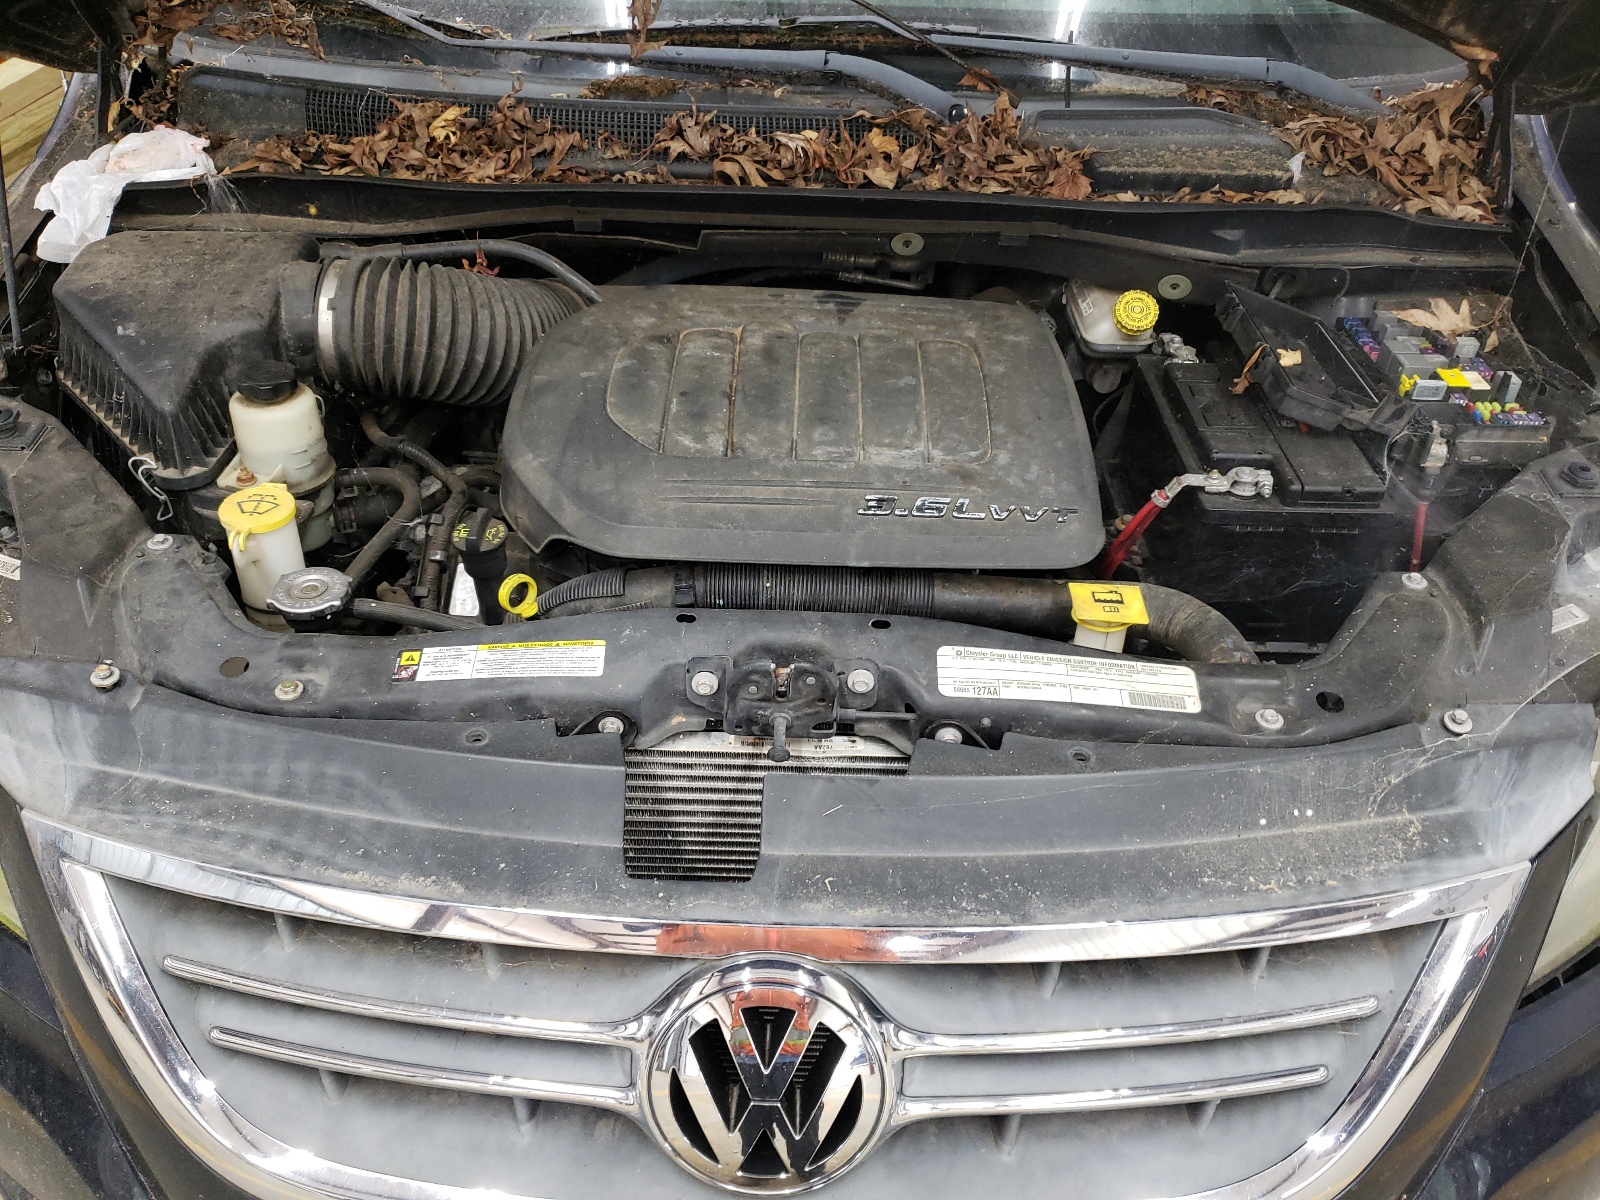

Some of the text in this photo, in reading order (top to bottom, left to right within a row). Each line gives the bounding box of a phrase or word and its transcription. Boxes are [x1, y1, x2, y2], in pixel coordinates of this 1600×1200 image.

[965, 650, 989, 658] Chrysler
[989, 651, 1007, 659] Group
[1022, 654, 1045, 662] VEHICLE
[1046, 656, 1072, 664] EMISSION
[1098, 661, 1136, 670] INFORMATION
[972, 686, 998, 697] 127AA
